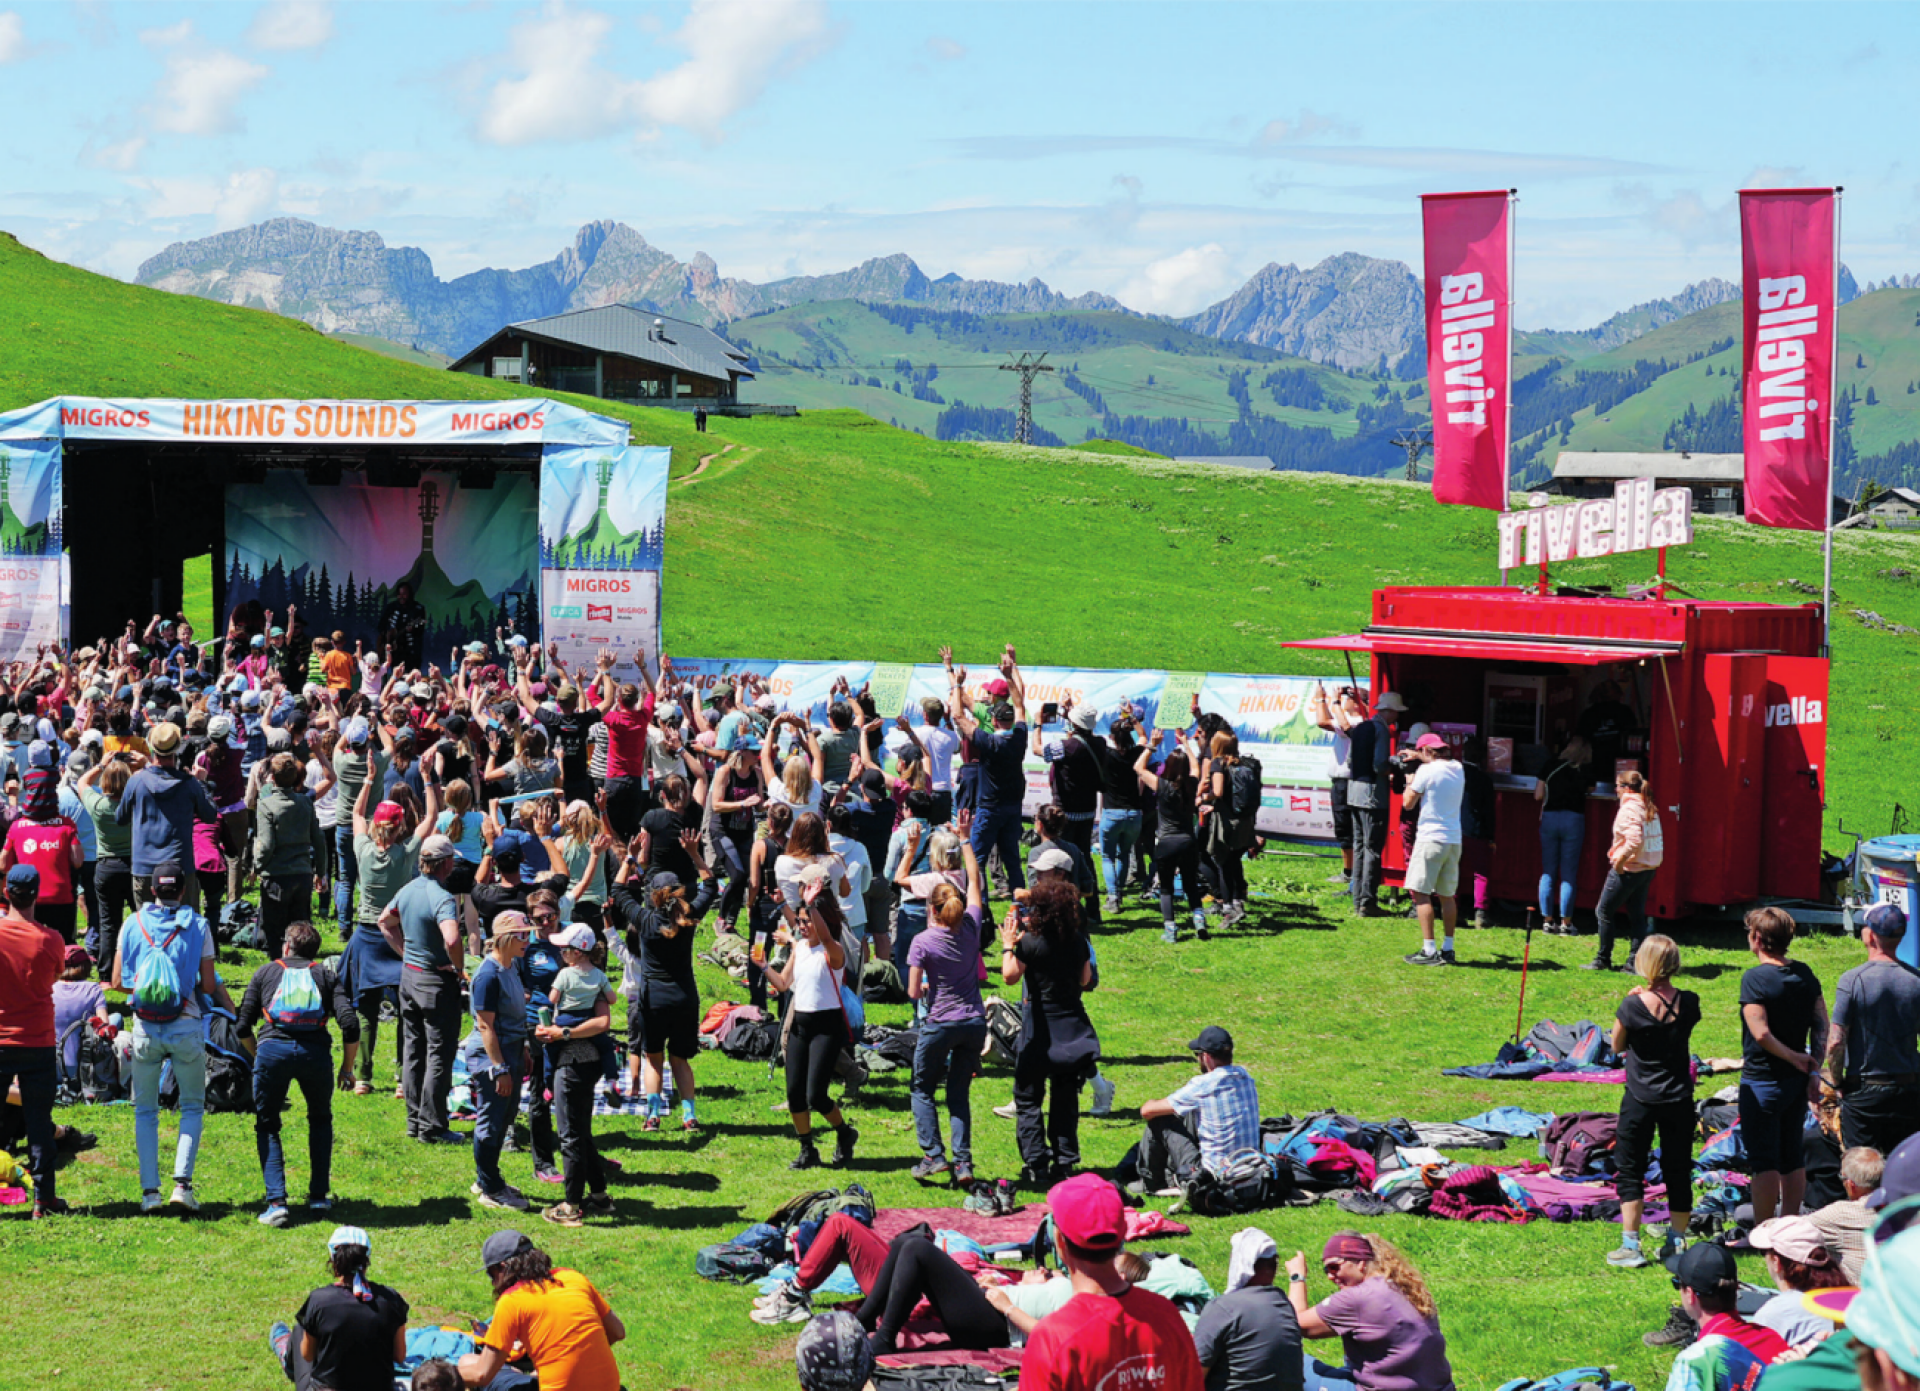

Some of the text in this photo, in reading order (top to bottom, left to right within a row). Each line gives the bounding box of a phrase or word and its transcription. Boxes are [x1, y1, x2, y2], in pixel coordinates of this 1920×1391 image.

[61, 408, 150, 428] MIGROS
[183, 404, 418, 438] HIKING SOUNDS
[451, 411, 545, 431] MIGROS
[1498, 477, 1694, 569] rivella
[566, 579, 631, 592] MIGROS
[1024, 684, 1084, 706] OUNDS
[1245, 682, 1281, 691] MIGROS
[1238, 694, 1299, 714] HIKING
[1764, 695, 1823, 728] vella
[40, 840, 60, 852] dpd
